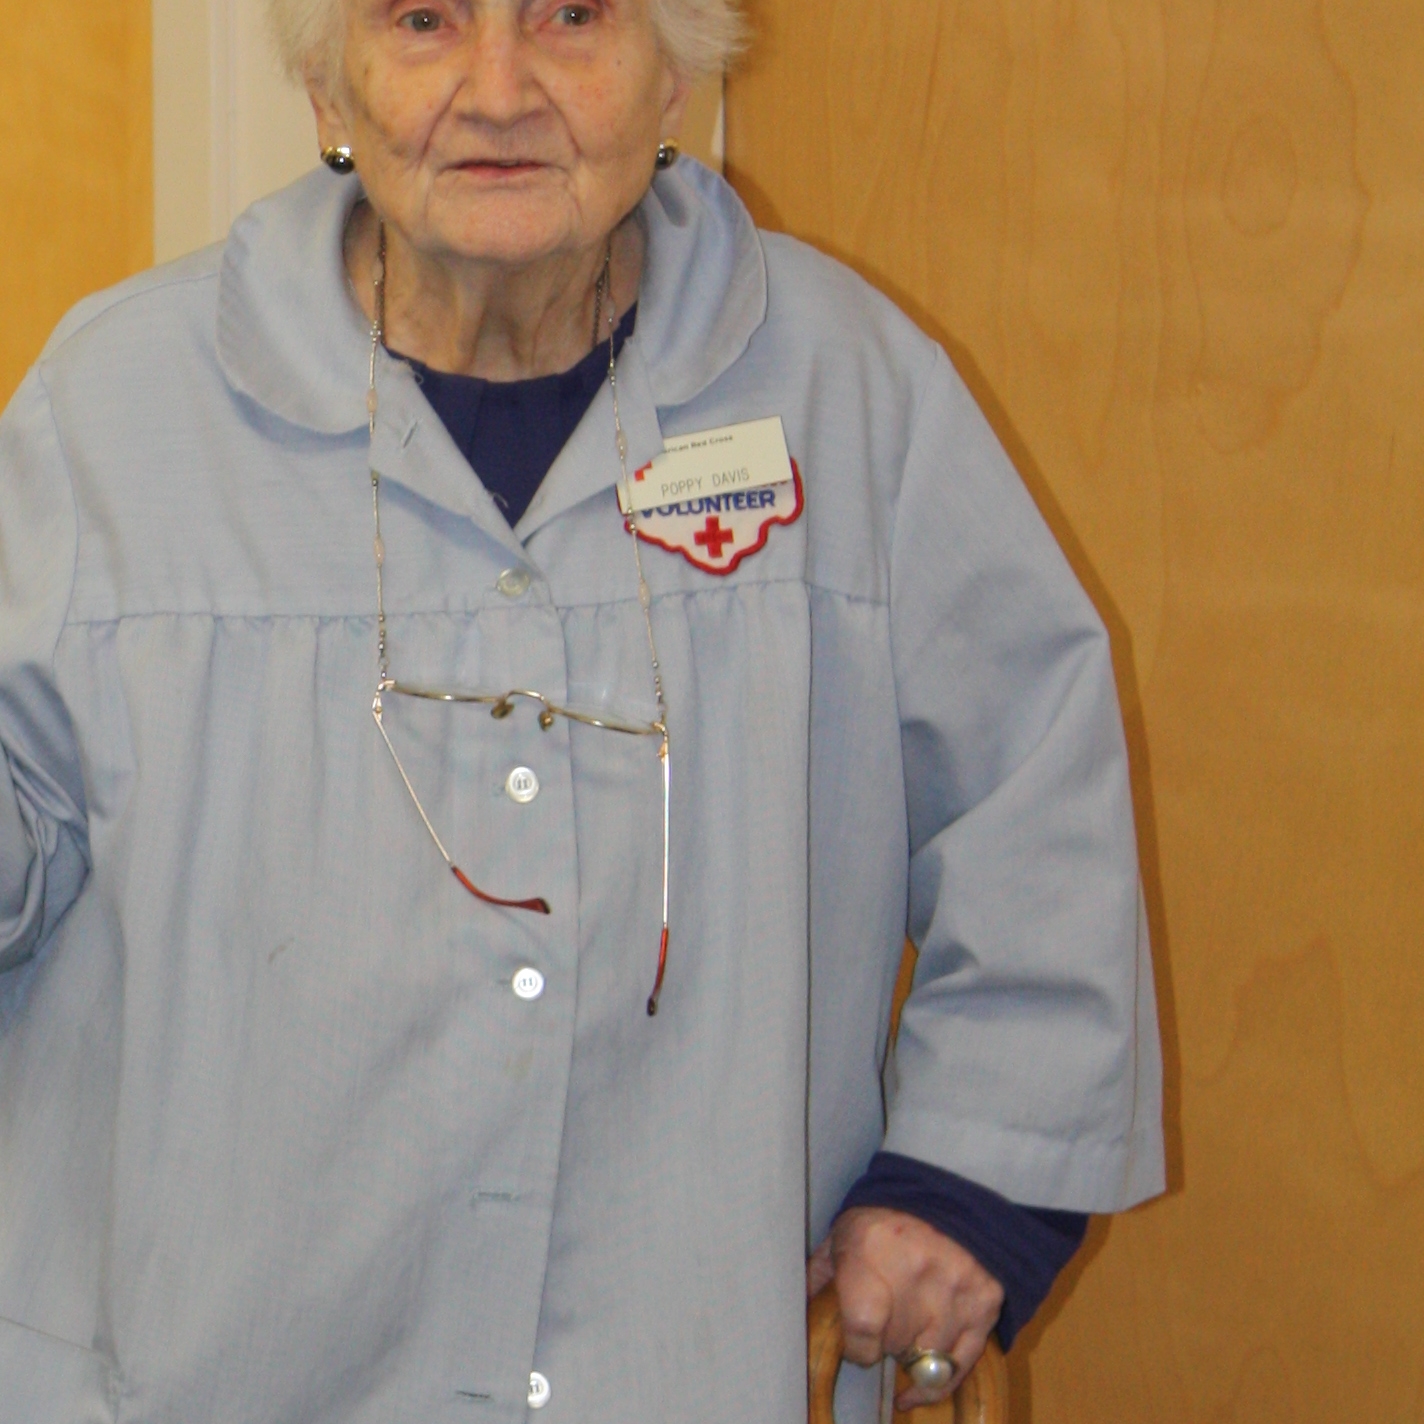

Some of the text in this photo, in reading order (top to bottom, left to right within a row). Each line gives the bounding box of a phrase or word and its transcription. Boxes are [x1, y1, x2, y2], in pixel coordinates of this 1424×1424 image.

[691, 439, 708, 449] Red
[709, 435, 734, 446] Cross
[661, 477, 702, 497] POPPY
[712, 467, 750, 487] DAVIS
